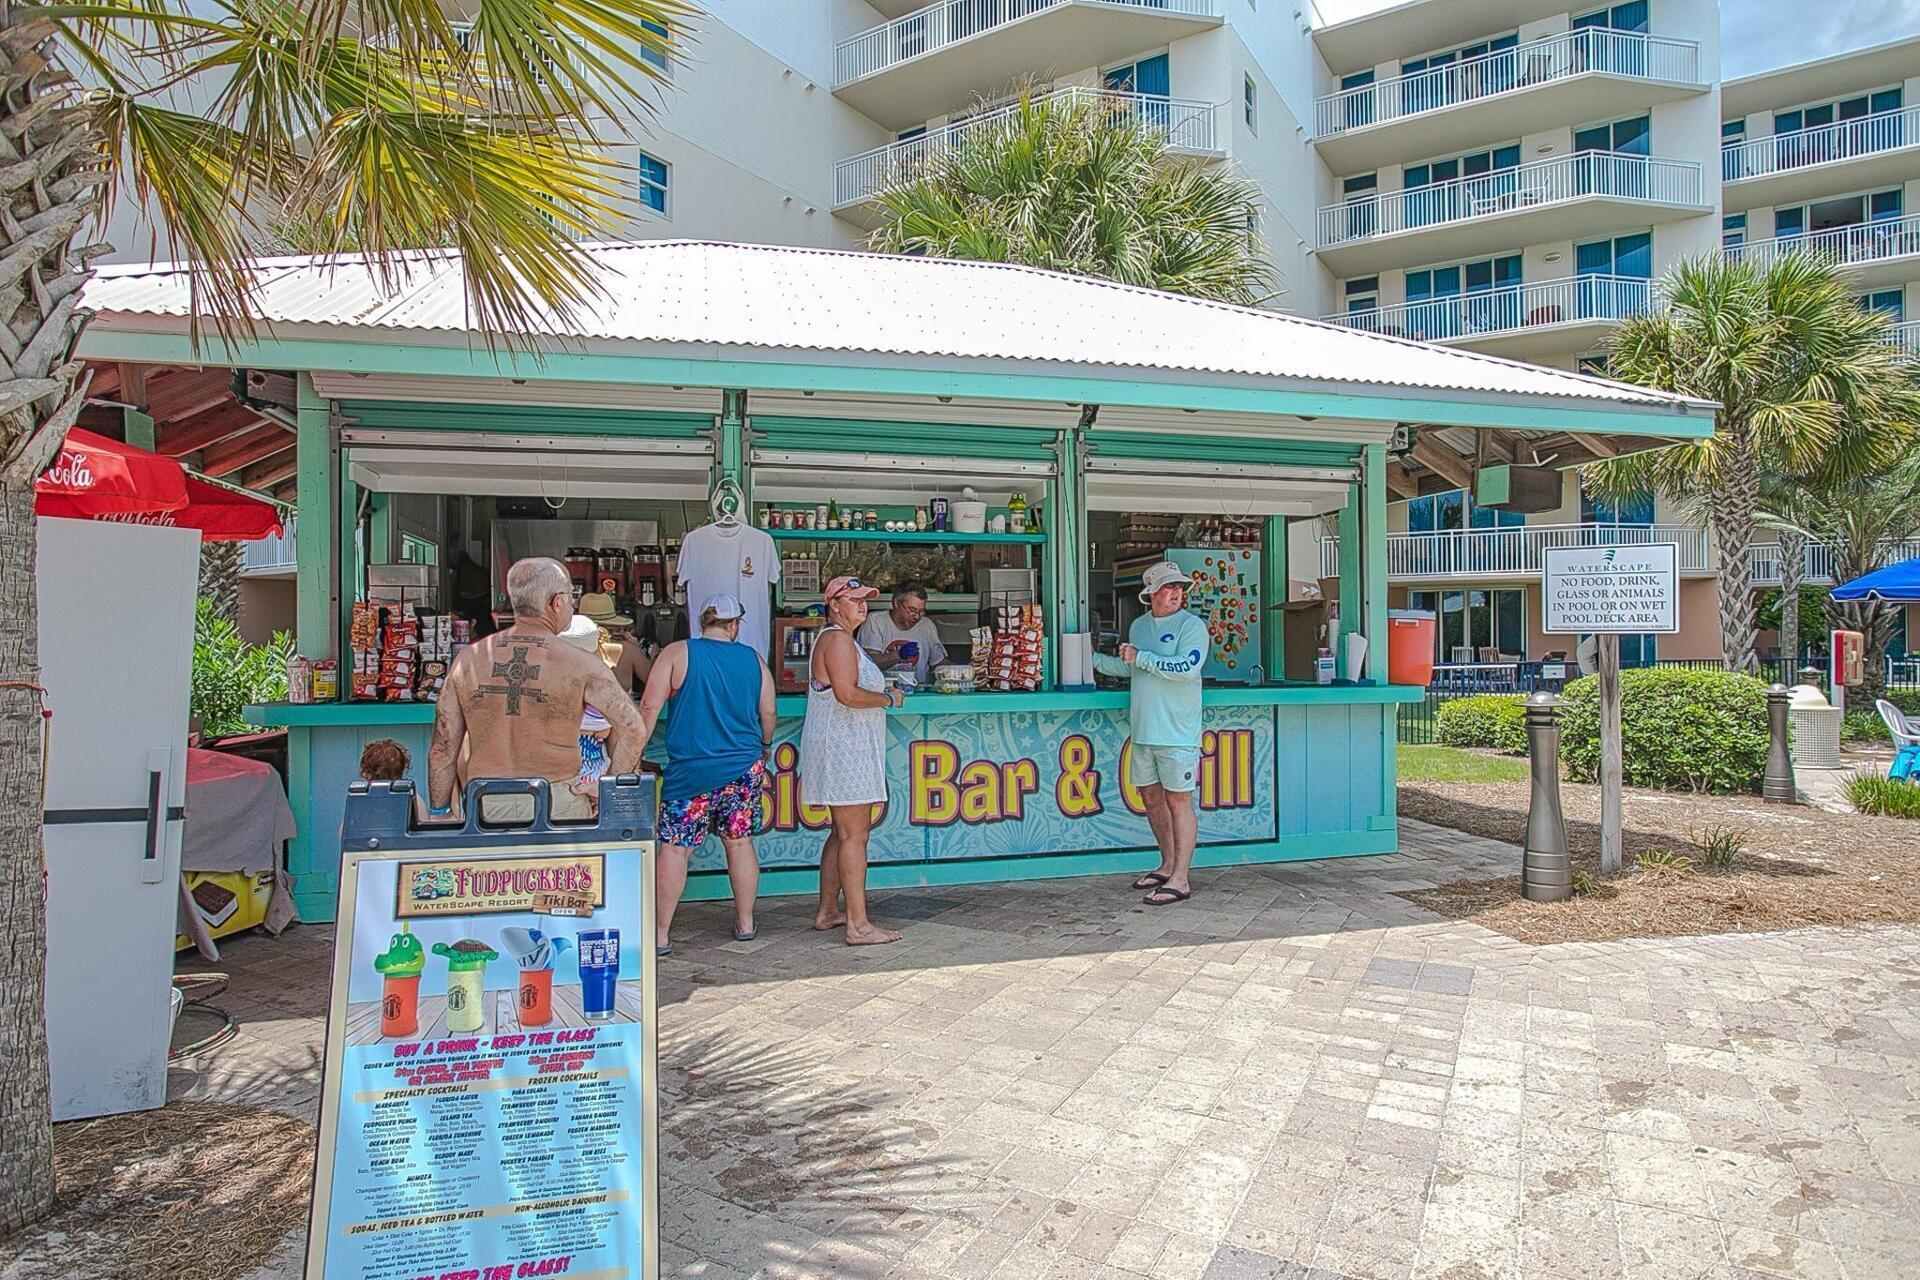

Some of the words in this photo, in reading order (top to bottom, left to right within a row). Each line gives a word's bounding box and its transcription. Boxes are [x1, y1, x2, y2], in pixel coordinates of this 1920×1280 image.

[1568, 564, 1652, 572] WATERSCAPE
[1561, 578, 1577, 587] NO
[1581, 577, 1615, 587] FOOD,
[1557, 589, 1591, 599] GLASS
[1592, 589, 1610, 599] OR
[1611, 588, 1665, 598] ANIMALS
[1552, 602, 1565, 611] IN
[1568, 602, 1598, 611] POOL
[1600, 602, 1618, 611] OR
[1619, 601, 1637, 610] ON
[1640, 600, 1667, 610] WET
[1562, 614, 1593, 624] POOL
[1594, 613, 1626, 623] DECK
[1627, 613, 1659, 623] AREA
[910, 739, 1038, 825] Bar
[1058, 735, 1104, 818] &
[1119, 729, 1254, 815] ill
[413, 901, 484, 910] WATERSCAPE
[543, 895, 565, 906] Tiki
[567, 896, 587, 908] Bar
[394, 1044, 420, 1058] BUY
[423, 1042, 434, 1055] A
[437, 1038, 480, 1055] DRINK
[528, 1032, 554, 1046] THE
[528, 1075, 558, 1086] FROZEN
[560, 1072, 599, 1083] COCKTAILS
[384, 1088, 426, 1099] SPECIALTY
[428, 1084, 469, 1095] COCKTAILS
[573, 1095, 596, 1103] TROPICAL
[598, 1092, 617, 1100] STORM
[375, 1100, 409, 1110] MARGARITA
[501, 1101, 536, 1111] STRAWBERRY
[538, 1098, 558, 1107] COLADA
[440, 1114, 460, 1122] ISLAND
[571, 1113, 593, 1122] BANANA
[498, 1120, 533, 1129] STRAWBERRY
[568, 1126, 588, 1134] FROZEN
[590, 1123, 621, 1132] MARGARITA
[502, 1134, 523, 1142] FROZEN
[525, 1130, 555, 1139] LEMONADE
[369, 1140, 388, 1148] OCEAN
[390, 1137, 410, 1146] WATER
[435, 1152, 456, 1160] BLOODY
[458, 1149, 475, 1157] MARY
[407, 1173, 432, 1182] MIMOSA
[515, 1200, 570, 1212] NON-ALCOHOLIC
[572, 1195, 607, 1206] DAIQUIRIS
[351, 1223, 379, 1234] SODAS,
[380, 1221, 397, 1231] ICED
[400, 1218, 416, 1228] TEA
[425, 1213, 456, 1225] BOTTLED
[458, 1210, 484, 1221] WATER
[483, 1265, 514, 1280] THE
[517, 1256, 571, 1278] GLASS!
